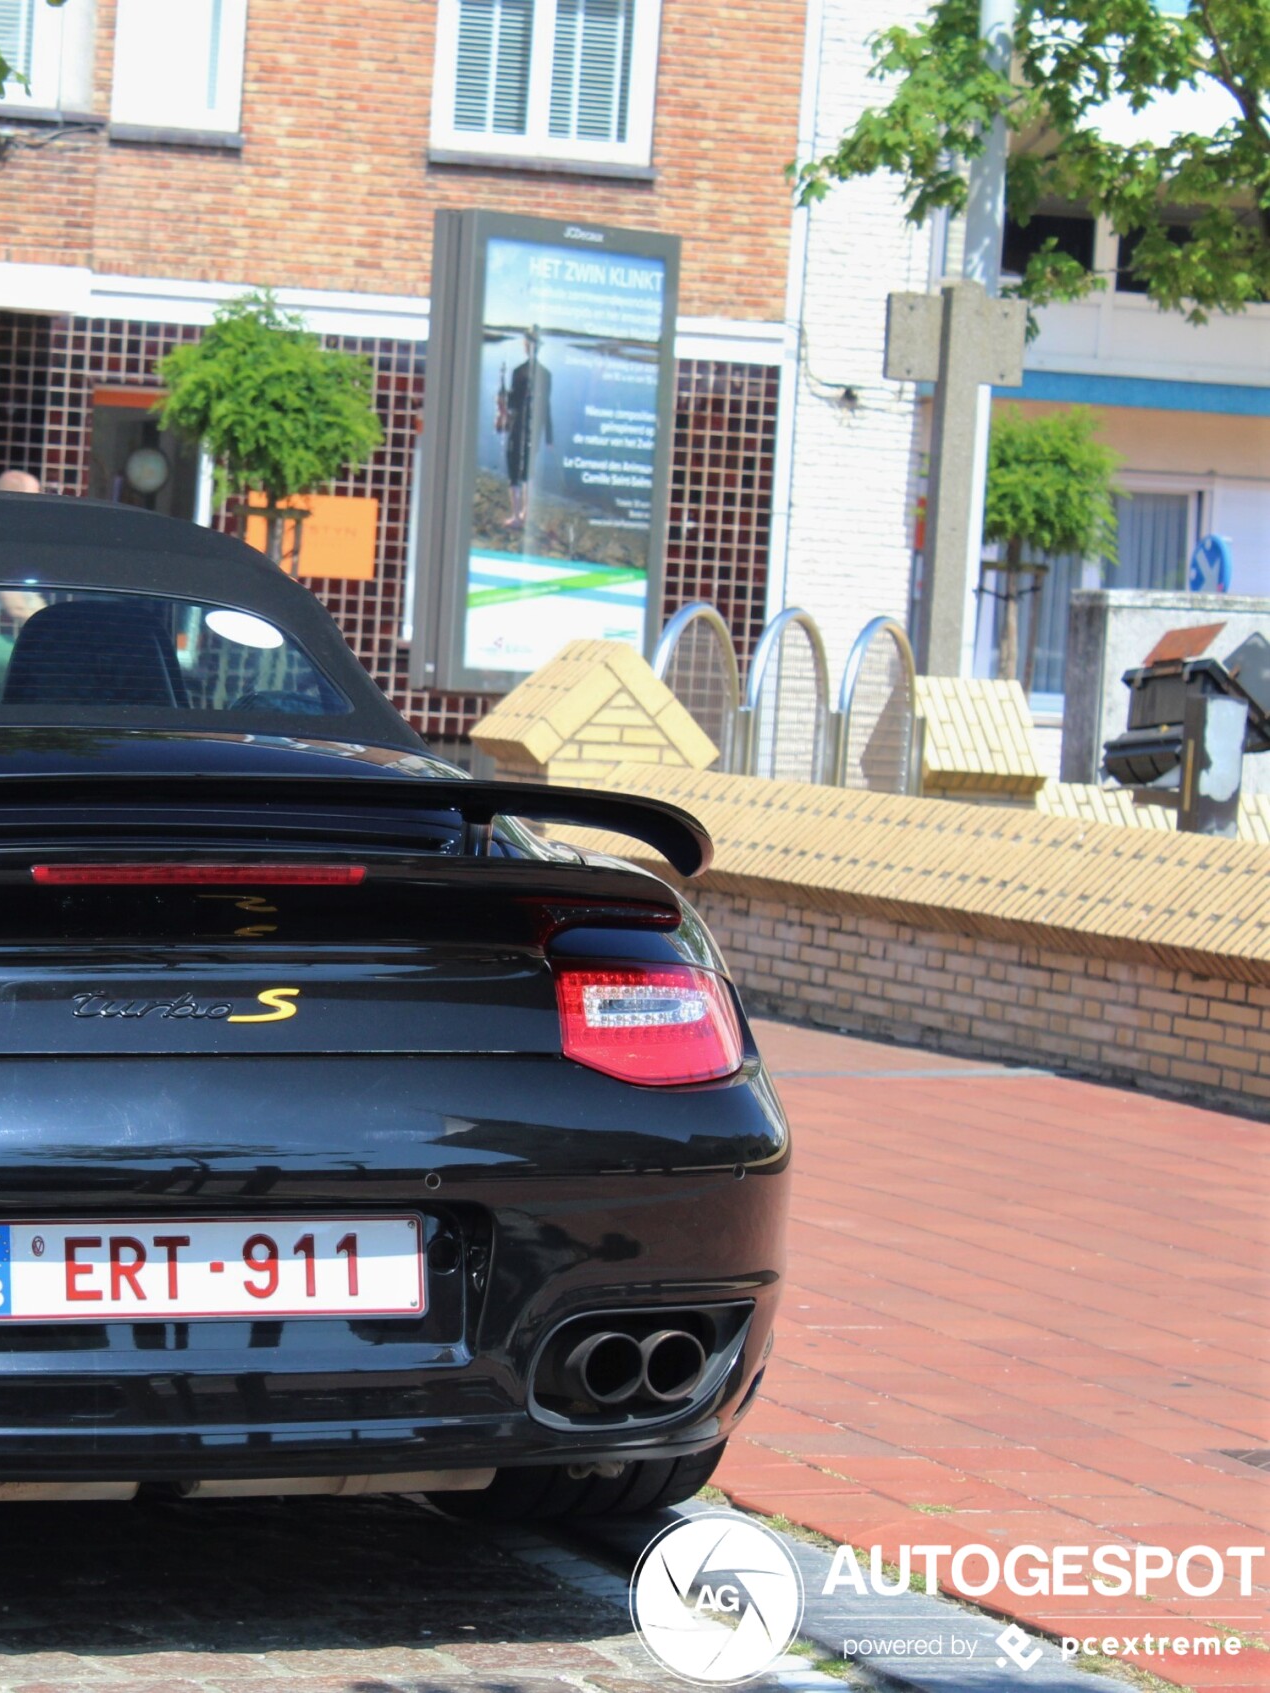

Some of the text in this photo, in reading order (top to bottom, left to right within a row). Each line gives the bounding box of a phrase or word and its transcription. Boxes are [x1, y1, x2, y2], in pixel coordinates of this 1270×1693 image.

[530, 256, 664, 293] HET ZWIN KLINKT
[72, 987, 301, 1023] Turbo S
